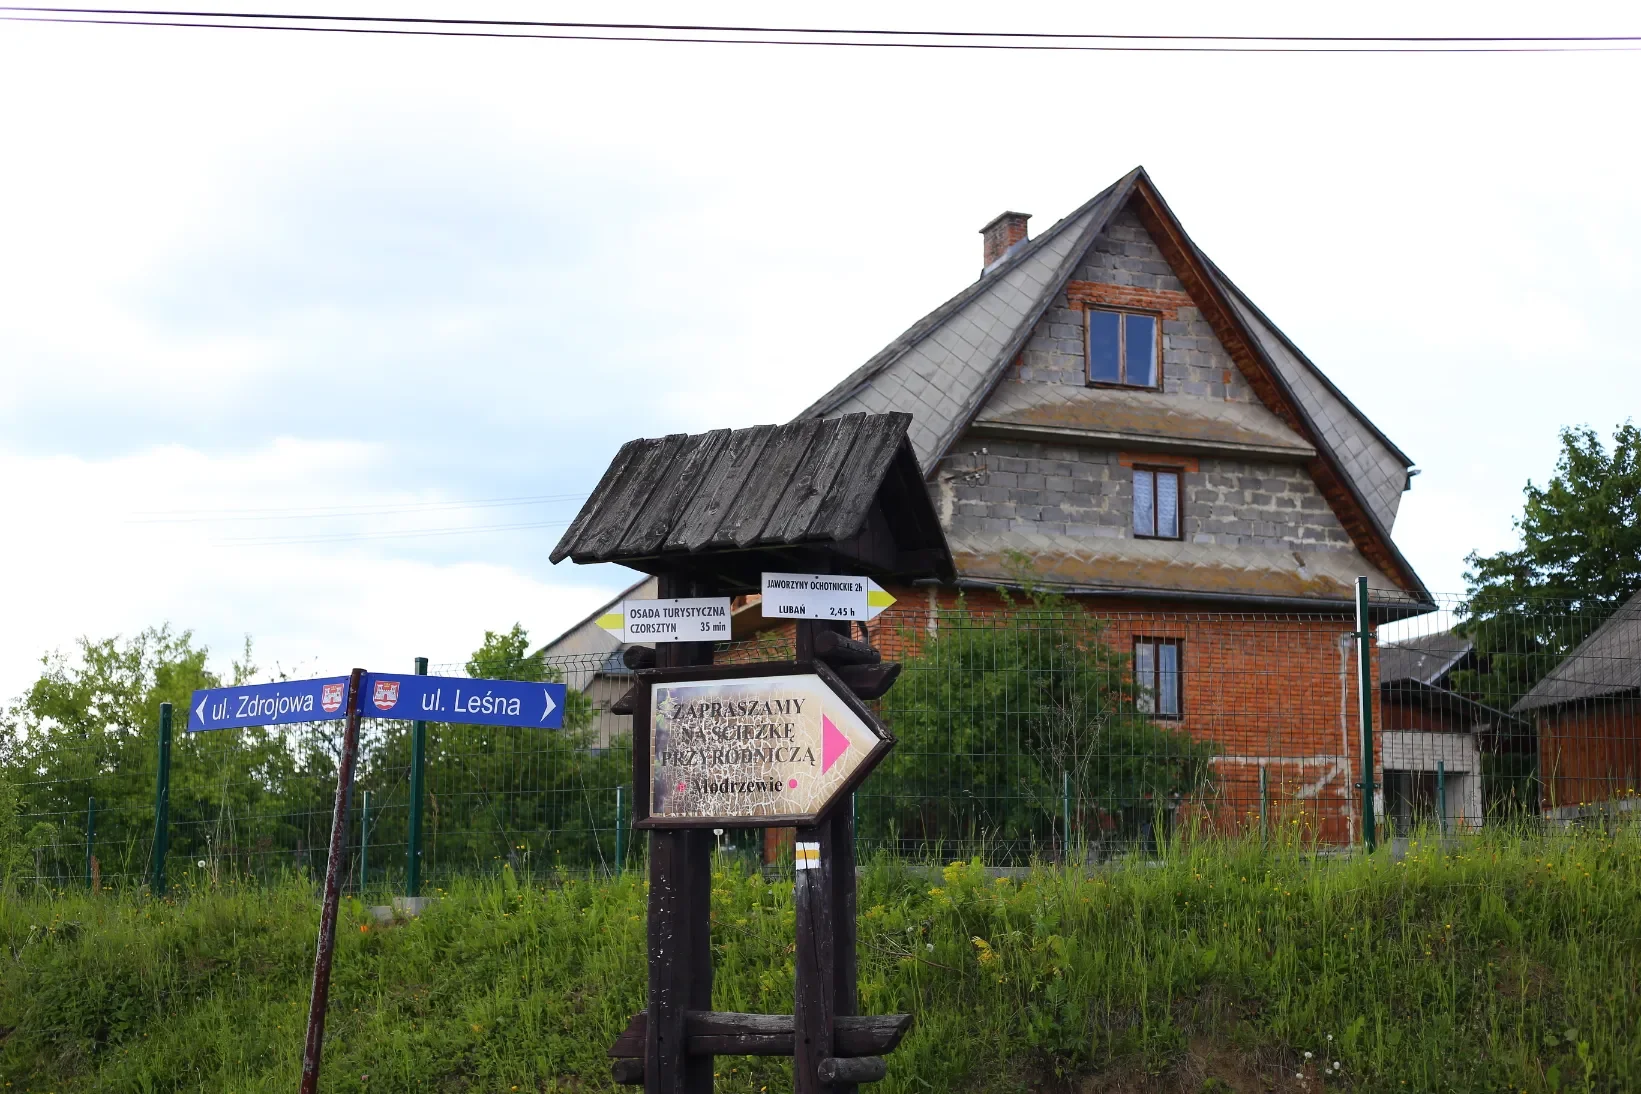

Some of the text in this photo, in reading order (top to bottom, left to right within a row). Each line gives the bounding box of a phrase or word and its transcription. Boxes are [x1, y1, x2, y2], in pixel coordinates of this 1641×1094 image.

[767, 579, 863, 592] JAWORZYNY OCHOTNICKIE 2h
[630, 606, 725, 619] OSADA TURYSTYCZNA
[779, 604, 855, 617] LUBAŃ 2,45 h
[630, 621, 726, 634] CZORSZTYN 35 min
[212, 692, 314, 721] ul. Zdrojowa
[421, 688, 521, 716] ul. Leśna
[672, 698, 806, 720] ZAPRASZAMY
[662, 746, 816, 767] PRZYRODNICZĄ
